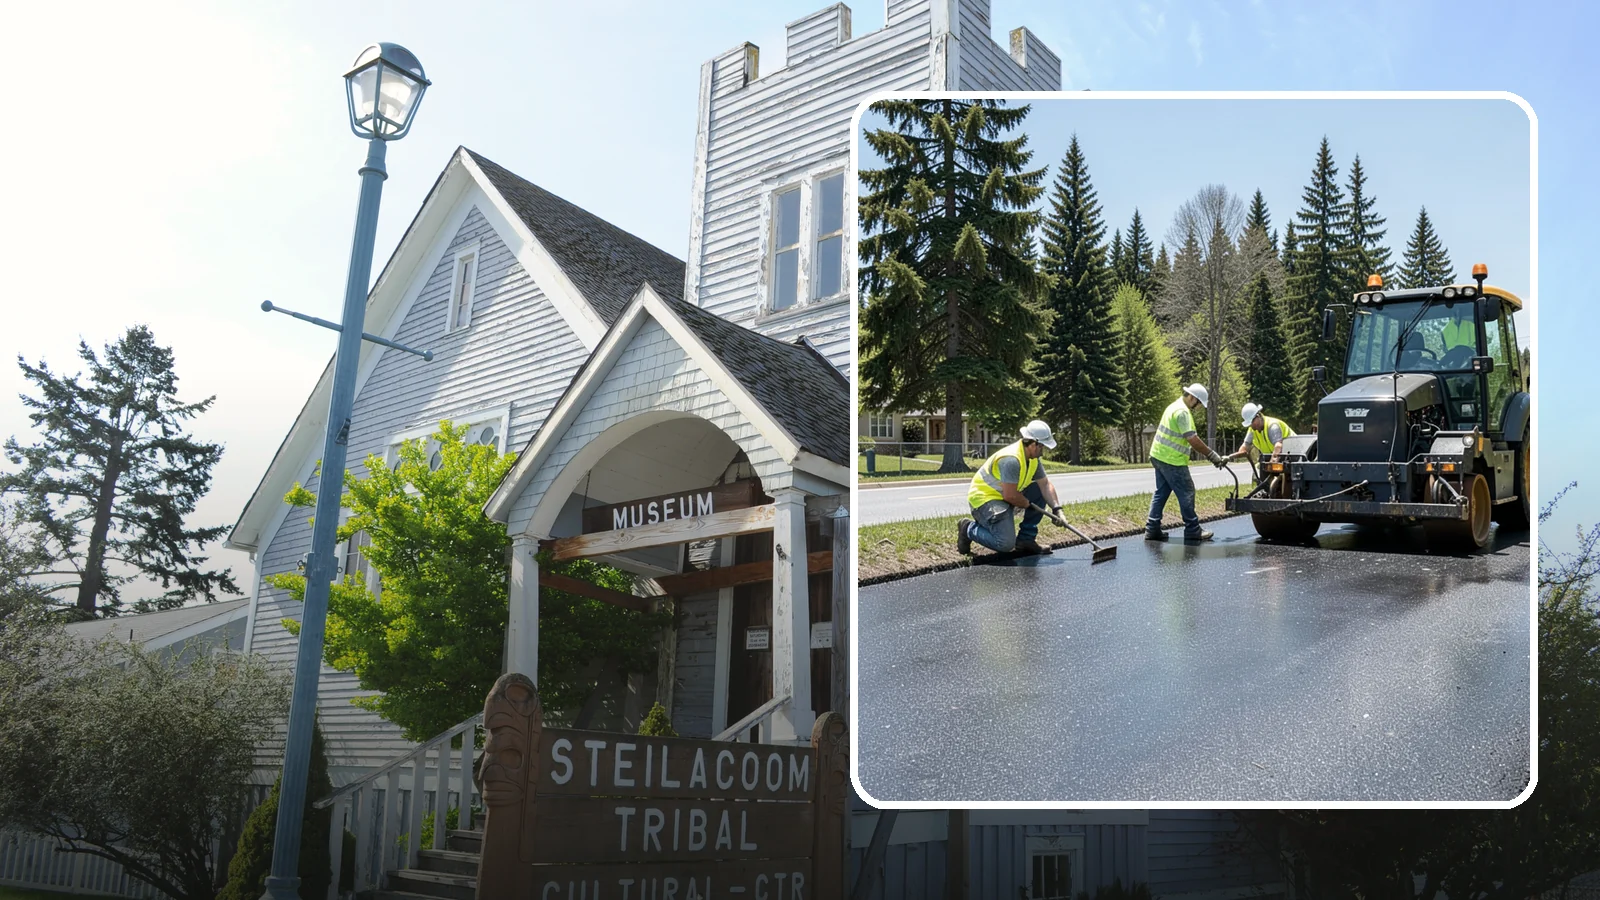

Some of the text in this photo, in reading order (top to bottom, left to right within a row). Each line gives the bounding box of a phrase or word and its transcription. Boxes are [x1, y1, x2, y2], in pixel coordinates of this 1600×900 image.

[613, 491, 714, 530] MUSEUM
[550, 738, 809, 793] STEILACOOM
[614, 806, 758, 852] TRIBAL
